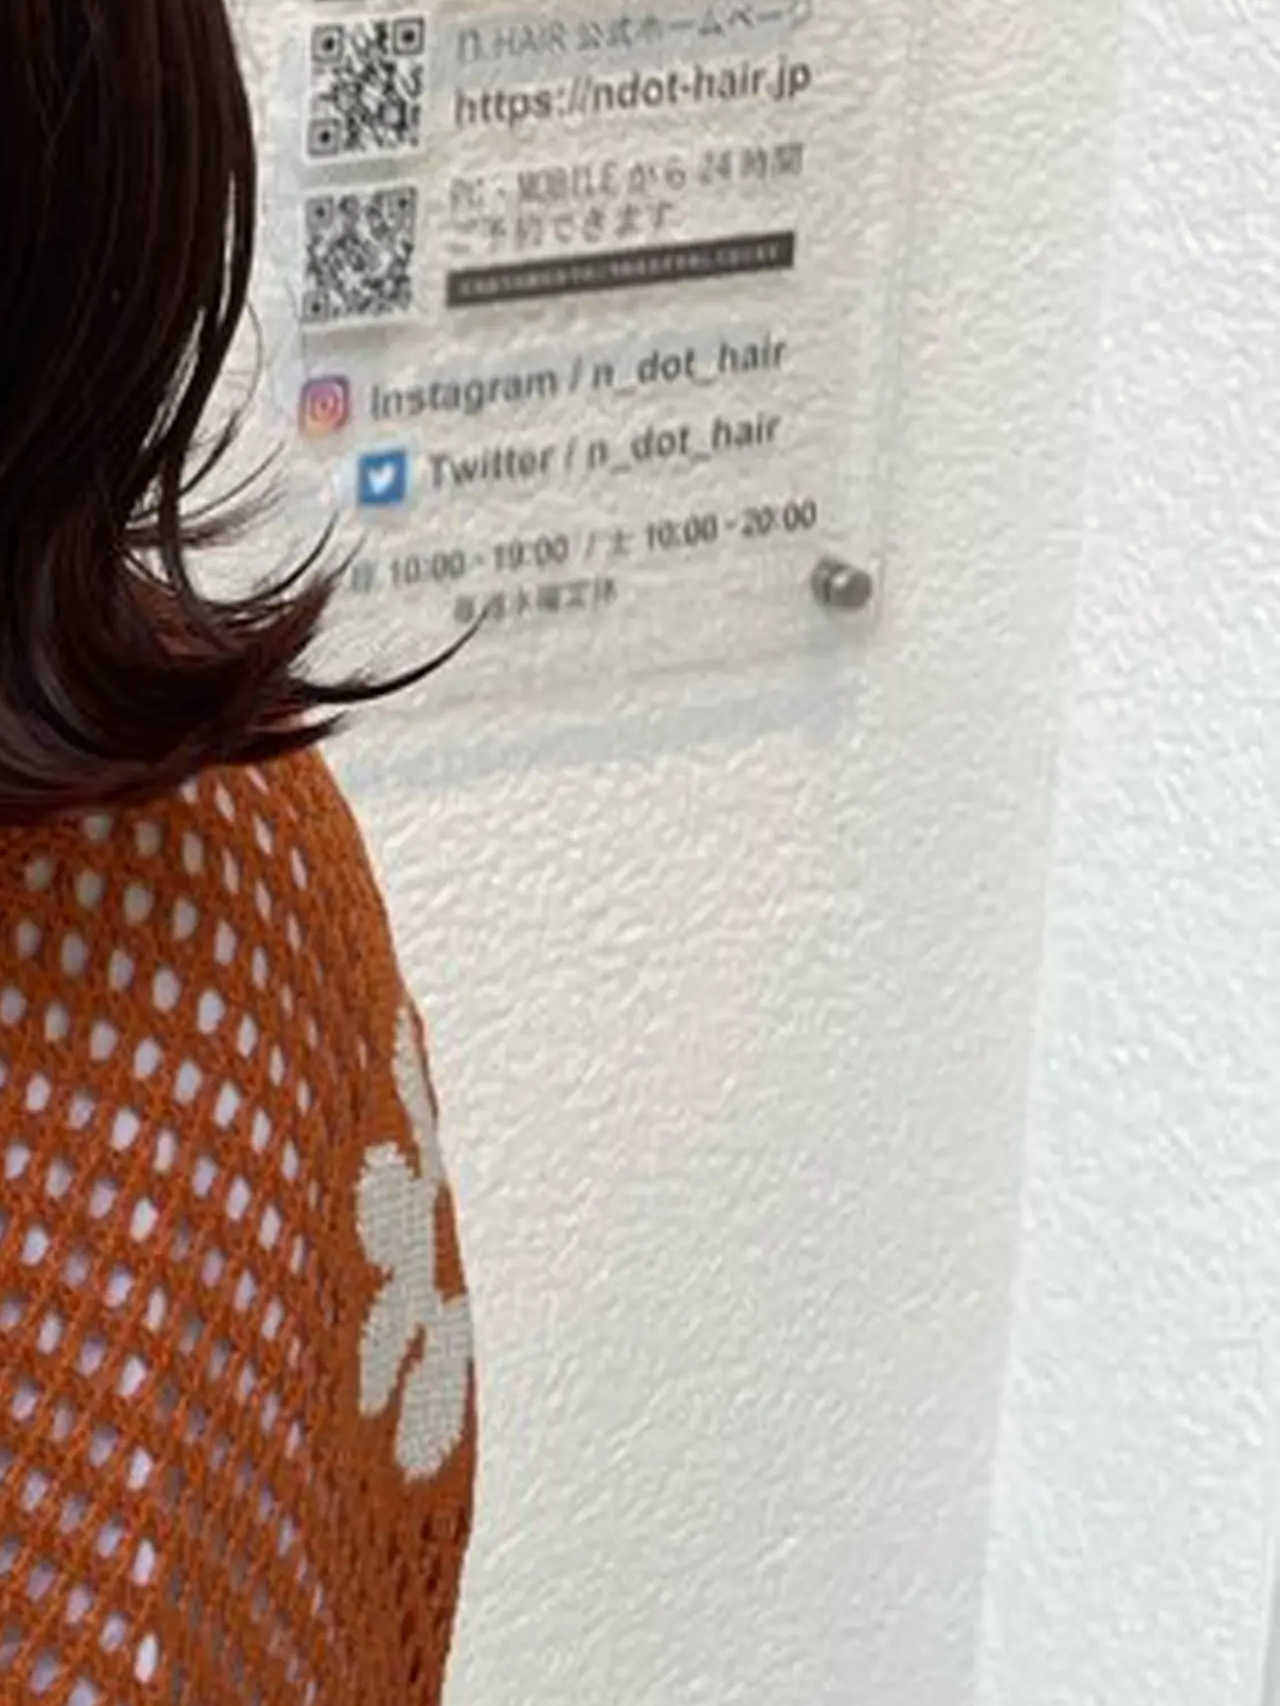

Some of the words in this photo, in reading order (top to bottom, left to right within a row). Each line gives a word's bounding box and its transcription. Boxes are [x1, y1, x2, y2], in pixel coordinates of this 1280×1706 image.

[453, 55, 812, 129] https://ndot-hair.jp
[370, 367, 559, 421] Instagram
[429, 444, 553, 489] Twitter
